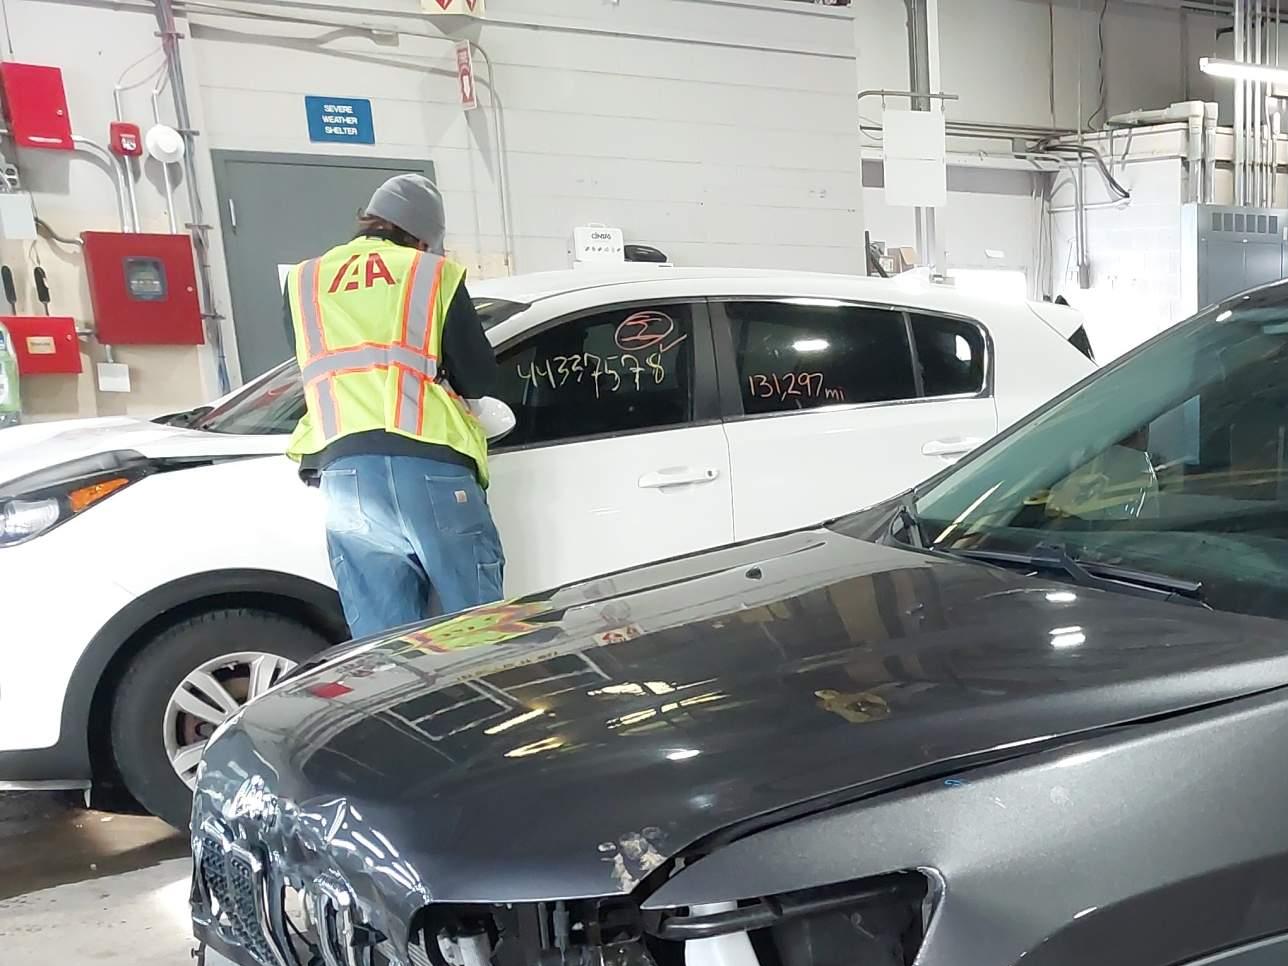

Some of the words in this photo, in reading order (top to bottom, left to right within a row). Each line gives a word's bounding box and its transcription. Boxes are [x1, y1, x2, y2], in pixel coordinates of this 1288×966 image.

[323, 104, 353, 113] SEVERE
[321, 115, 358, 125] WEATHER
[324, 126, 358, 135] SHELTER
[517, 352, 664, 400] 44337578
